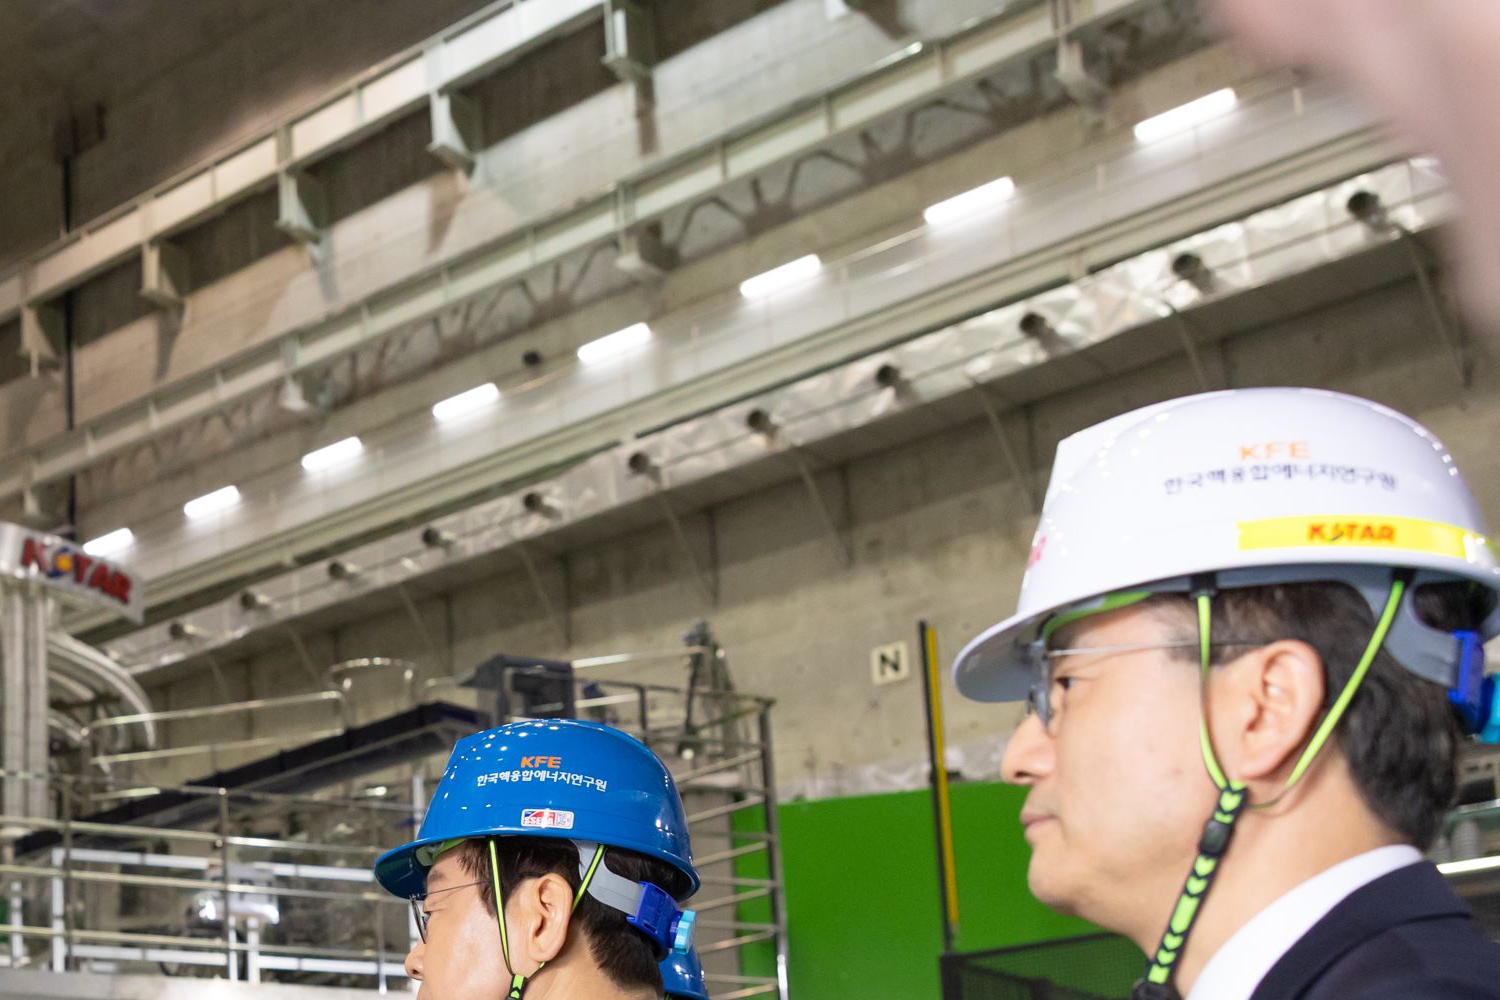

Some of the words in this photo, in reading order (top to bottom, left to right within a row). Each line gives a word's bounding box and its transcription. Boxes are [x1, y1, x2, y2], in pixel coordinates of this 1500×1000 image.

[1239, 441, 1311, 461] KFE
[879, 650, 900, 676] N
[520, 755, 562, 769] KFE
[476, 768, 607, 793] 한국핵융합에너지연구원
